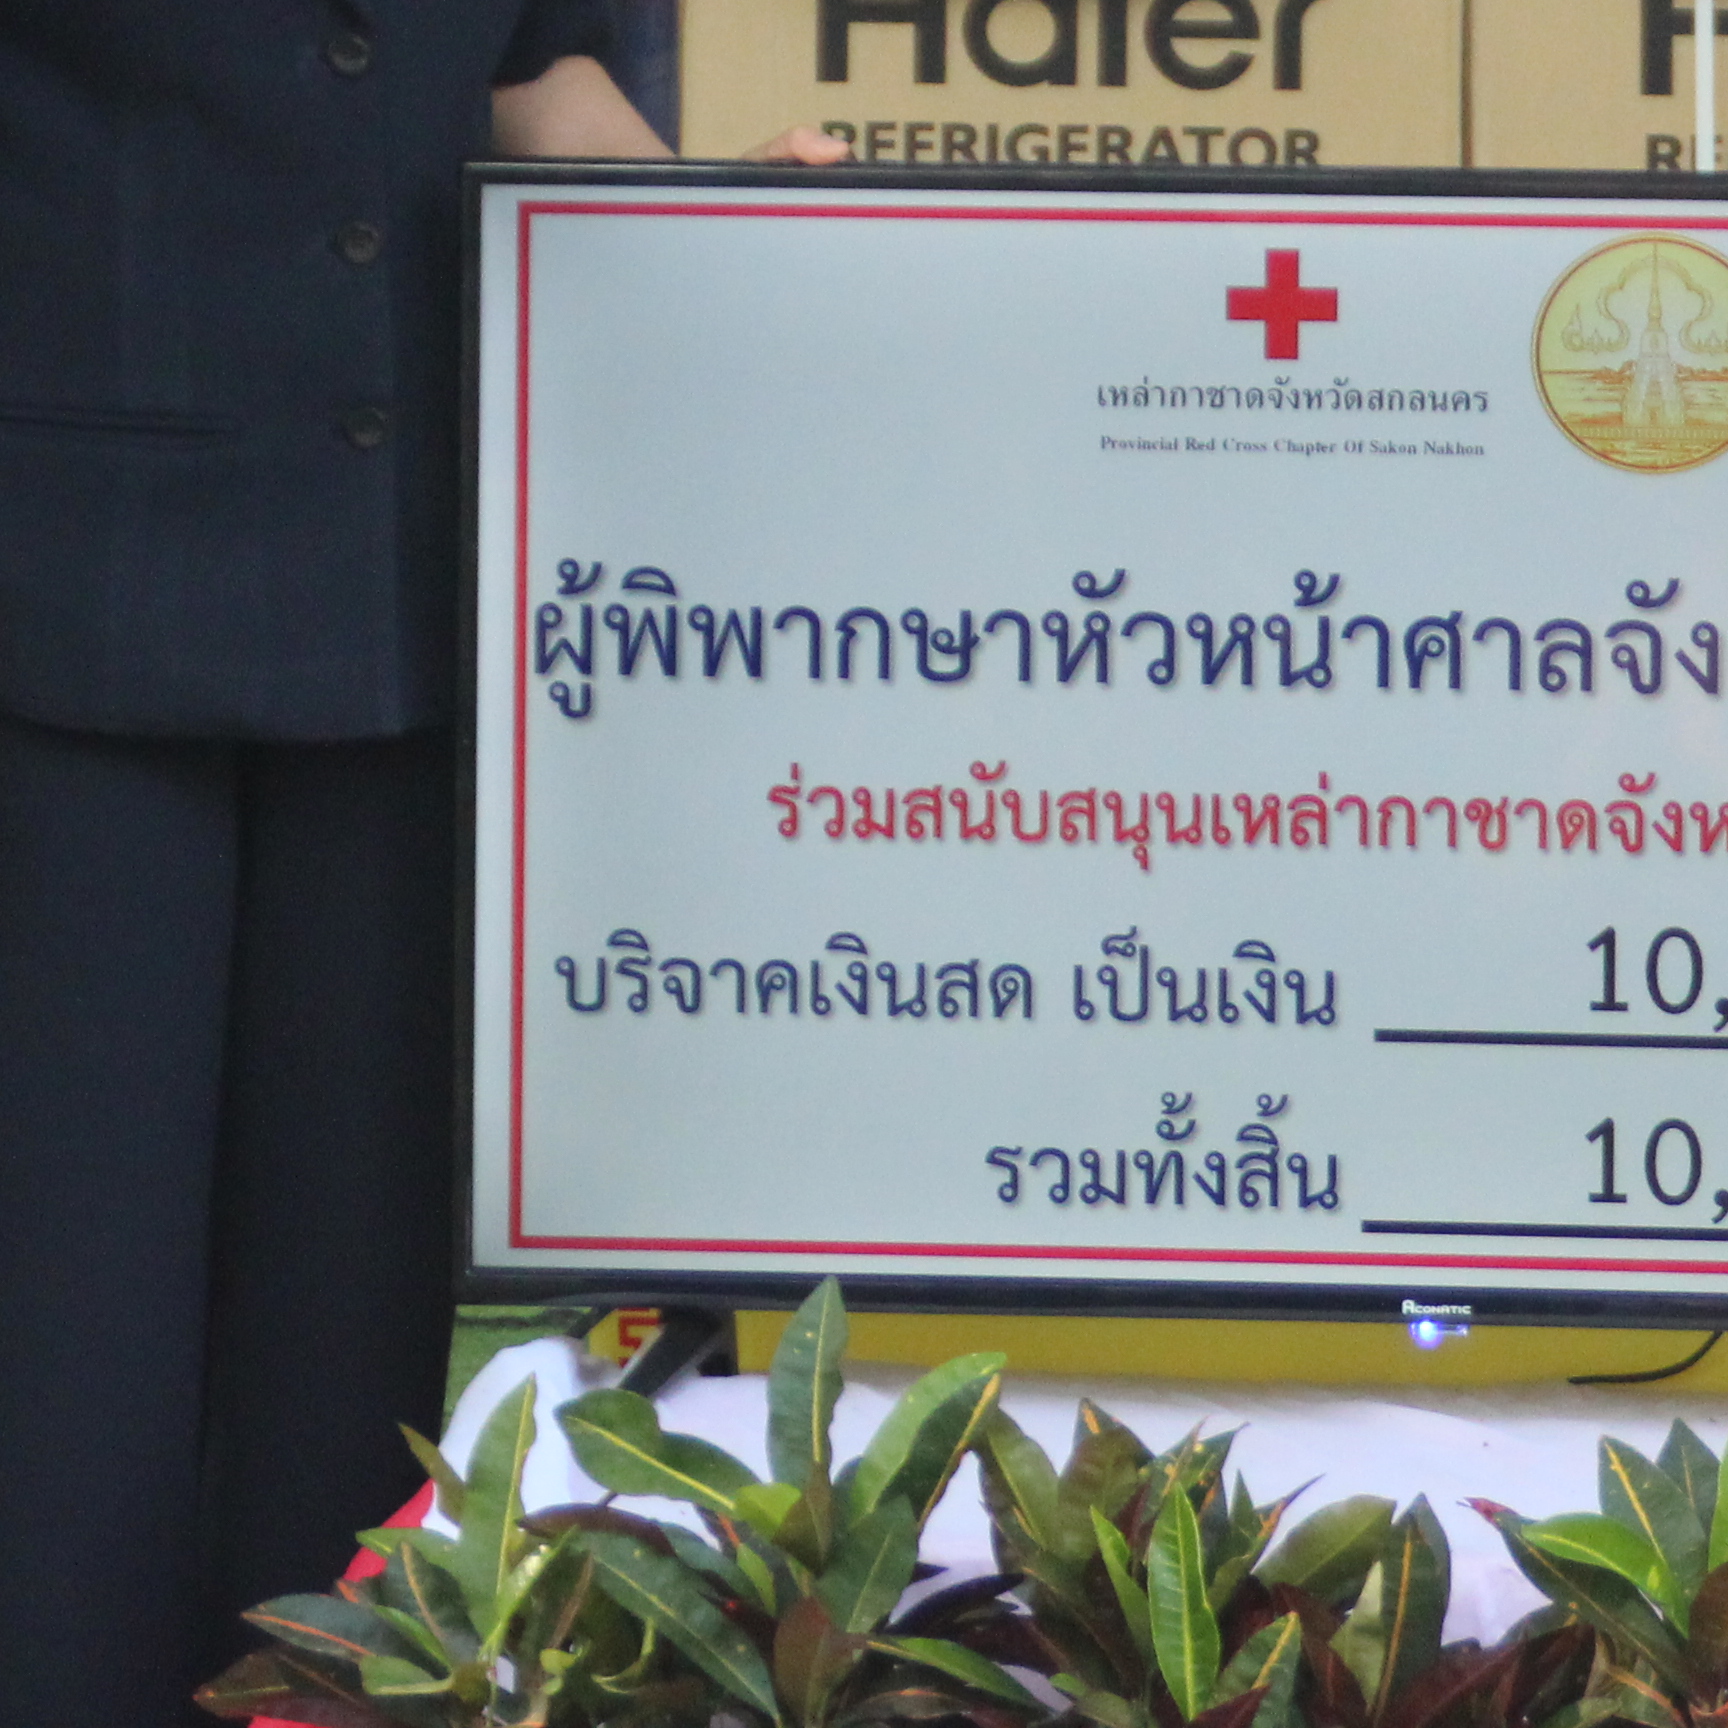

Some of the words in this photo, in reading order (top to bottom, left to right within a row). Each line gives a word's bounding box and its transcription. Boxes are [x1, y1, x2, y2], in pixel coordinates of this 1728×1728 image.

[1097, 375, 1489, 413] เหล่ากาชาดจังหวัดสกลนคร
[1100, 435, 1178, 451] Provincial
[1185, 436, 1216, 452] Red
[1223, 437, 1268, 452] Cross
[1273, 438, 1336, 456] Chapter
[1369, 440, 1417, 455] Sakon
[1423, 440, 1485, 456] Nakhon
[555, 927, 1035, 1020] บริจาคเงินสด
[1071, 925, 1338, 1026] เป็นเงิน
[984, 1091, 1341, 1212] รวมทั้งสิ้น
